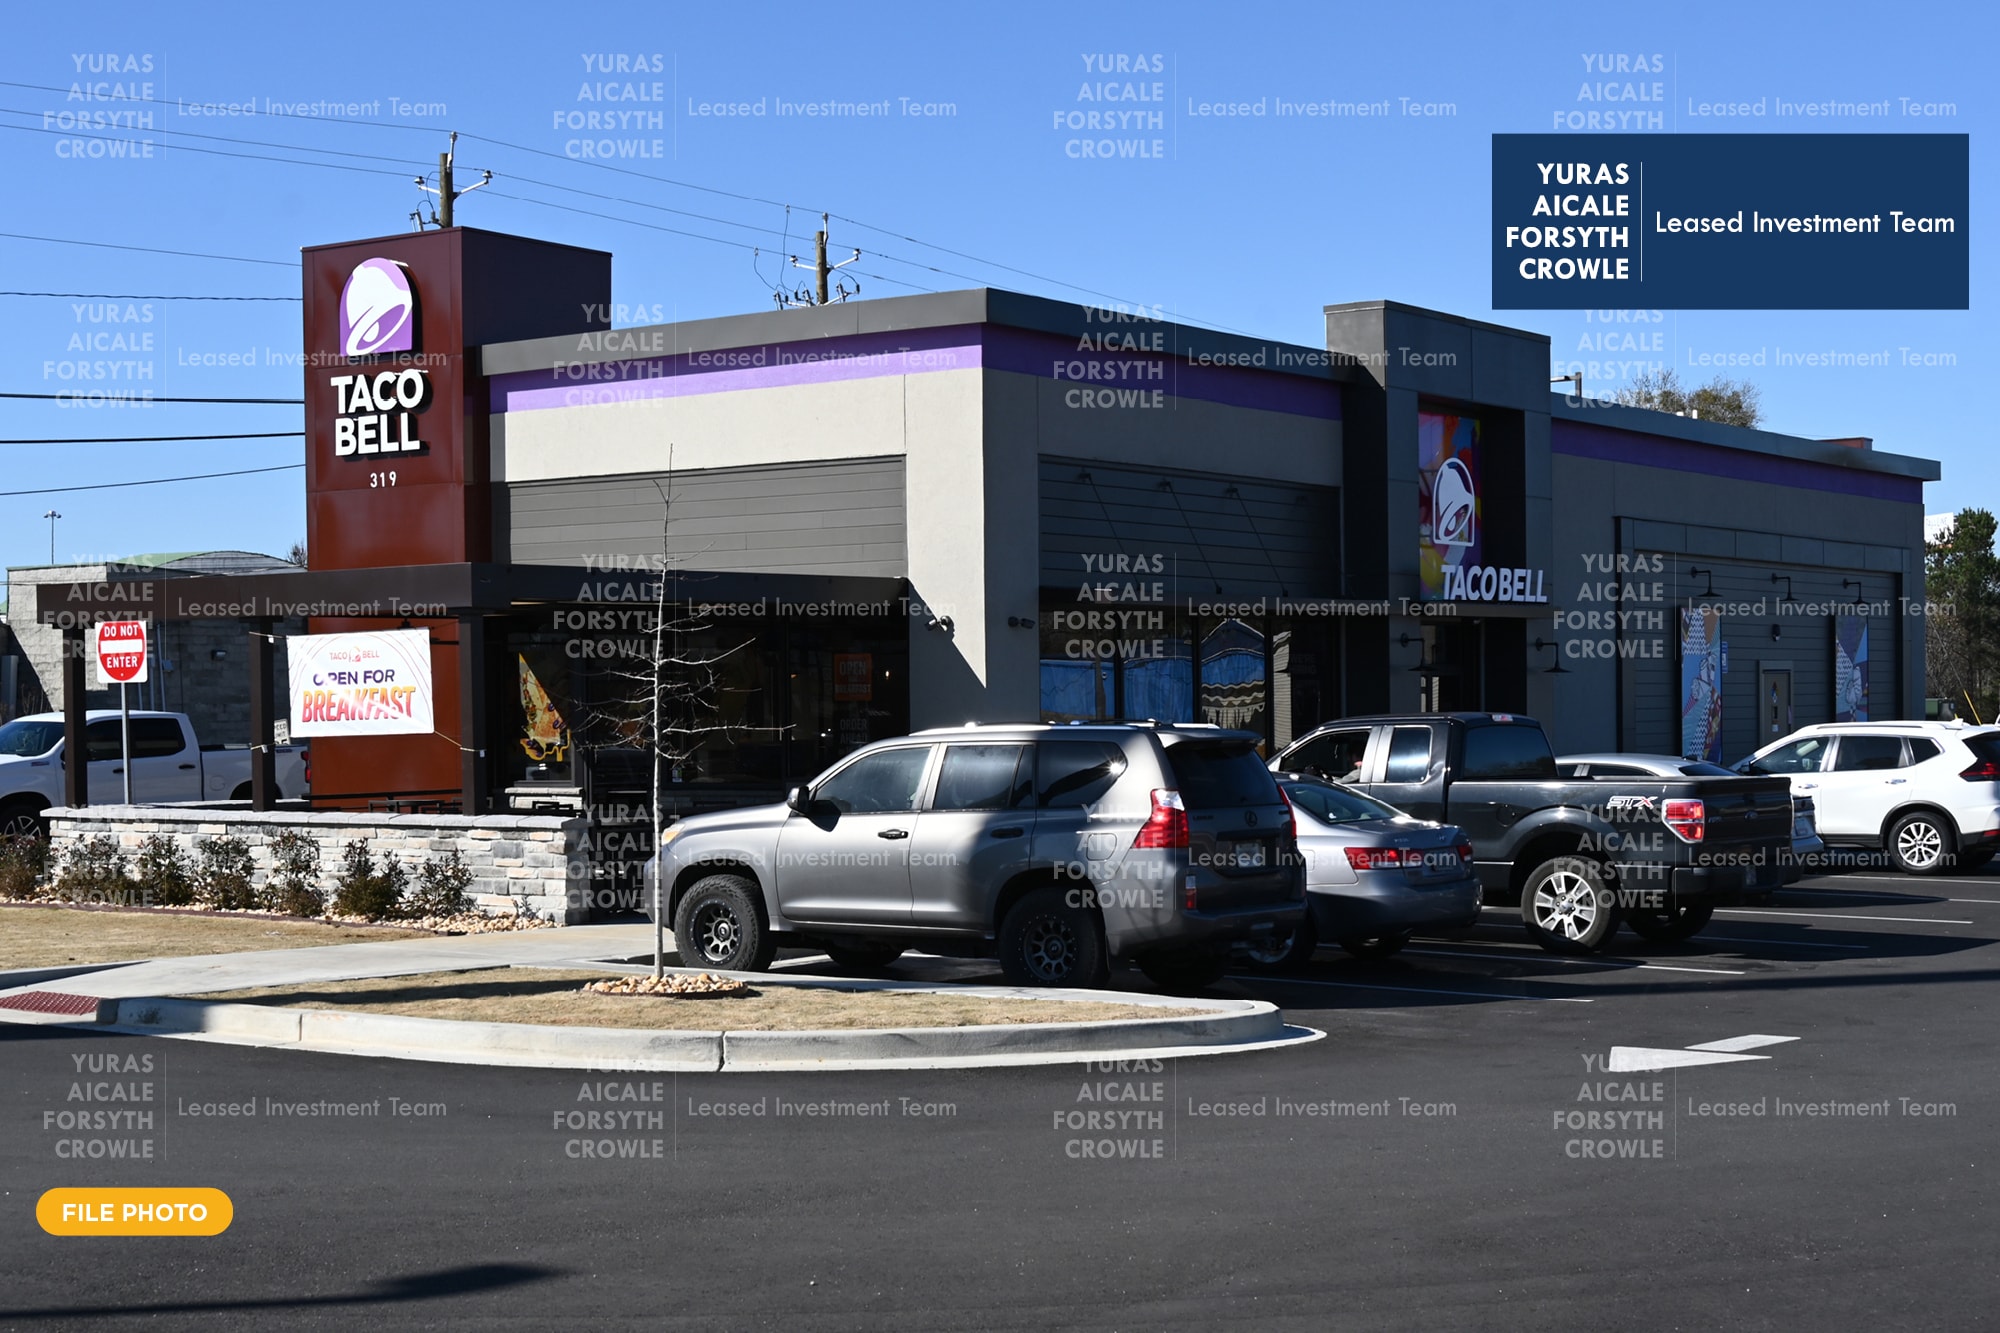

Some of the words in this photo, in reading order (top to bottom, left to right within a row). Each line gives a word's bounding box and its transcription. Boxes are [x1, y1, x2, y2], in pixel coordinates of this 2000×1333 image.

[330, 368, 424, 414] TACO
[335, 412, 420, 456] BELL
[370, 471, 397, 488] 319
[104, 626, 117, 637] DO
[120, 625, 139, 636] NOT
[106, 656, 138, 668] ENTER
[329, 651, 347, 660] TACO
[362, 650, 380, 659] BELL
[839, 660, 867, 675] OPEN
[313, 671, 359, 687] OPEN
[363, 669, 395, 684] FOR
[302, 685, 416, 723] BREAKFAST
[1606, 795, 1659, 810] STX
